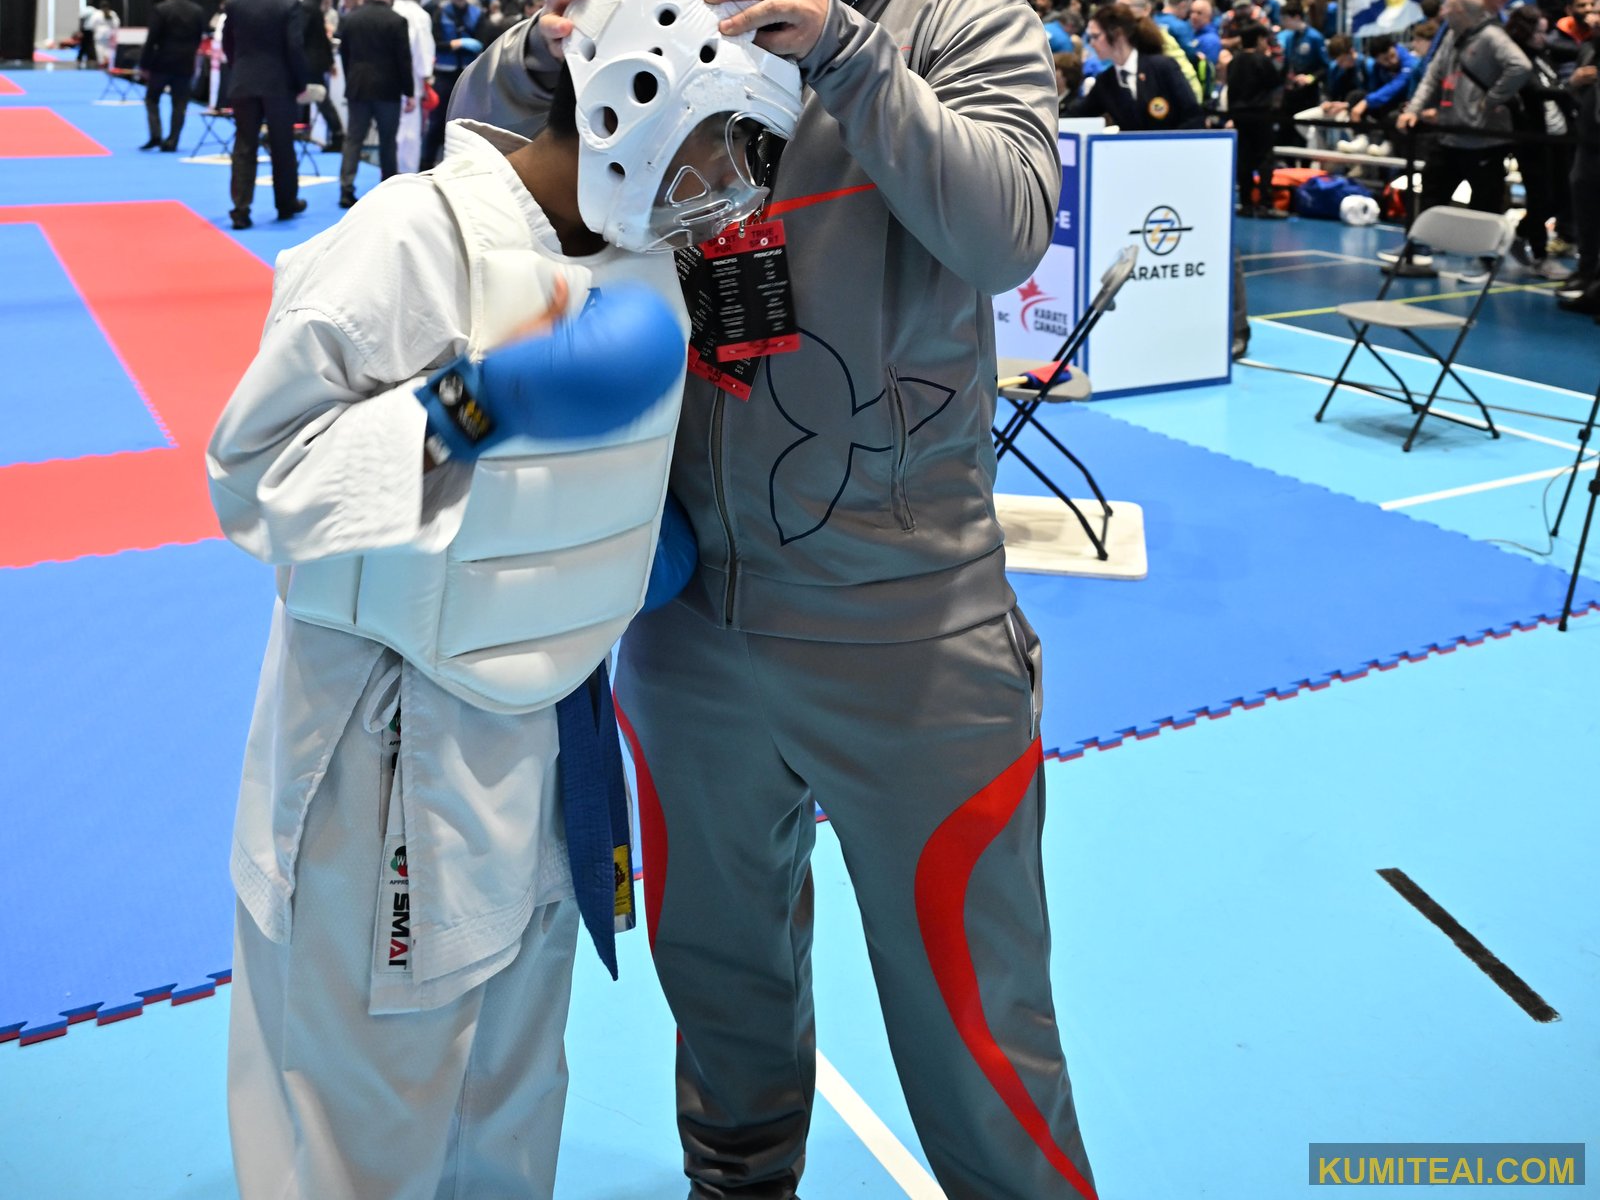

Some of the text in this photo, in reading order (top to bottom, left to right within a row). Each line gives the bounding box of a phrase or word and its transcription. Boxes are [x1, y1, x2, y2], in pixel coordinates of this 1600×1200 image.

[1185, 262, 1205, 277] BC
[1033, 308, 1068, 325] KARATE
[1033, 320, 1069, 337] CANADA
[388, 892, 410, 966] SMAI
